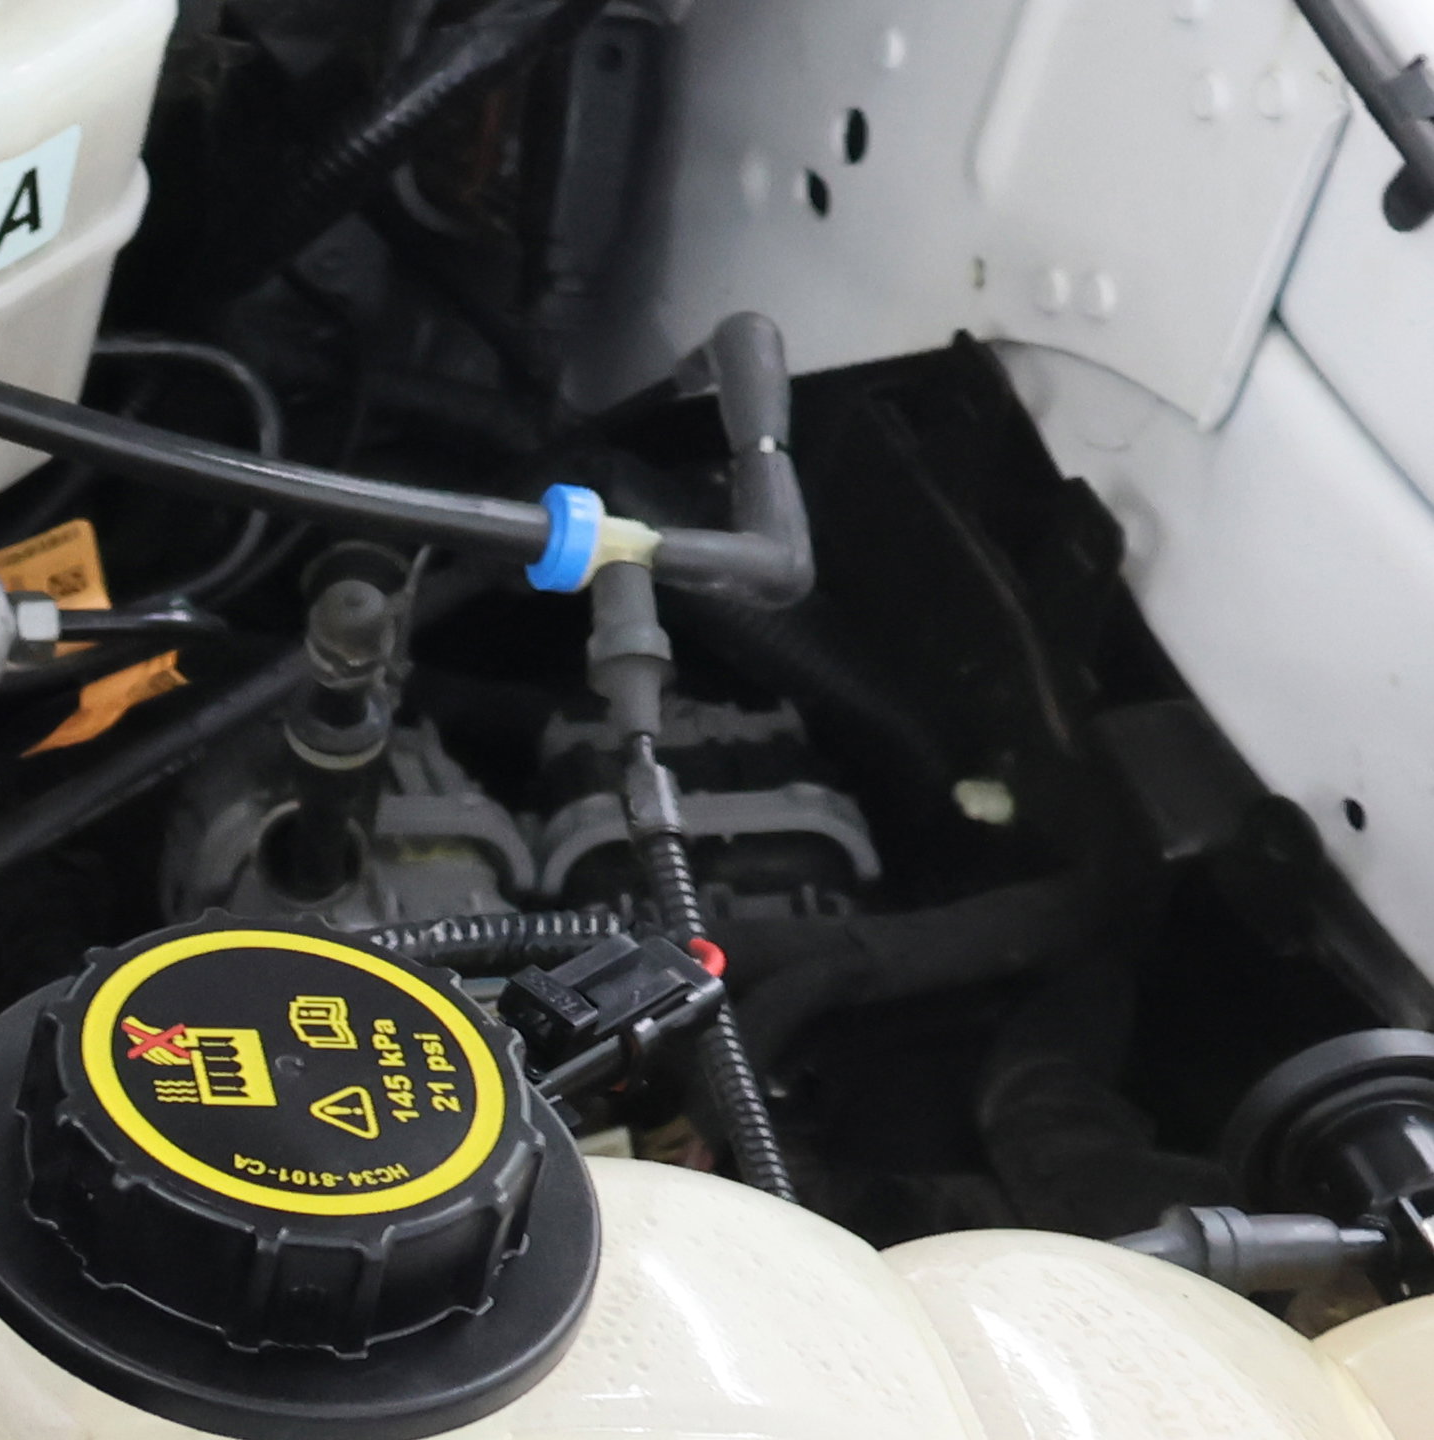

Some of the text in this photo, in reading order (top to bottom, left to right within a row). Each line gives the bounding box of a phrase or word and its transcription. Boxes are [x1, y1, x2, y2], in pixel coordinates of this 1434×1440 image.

[373, 1018, 419, 1123] 145 kPa
[413, 1031, 462, 1114] 21 psi
